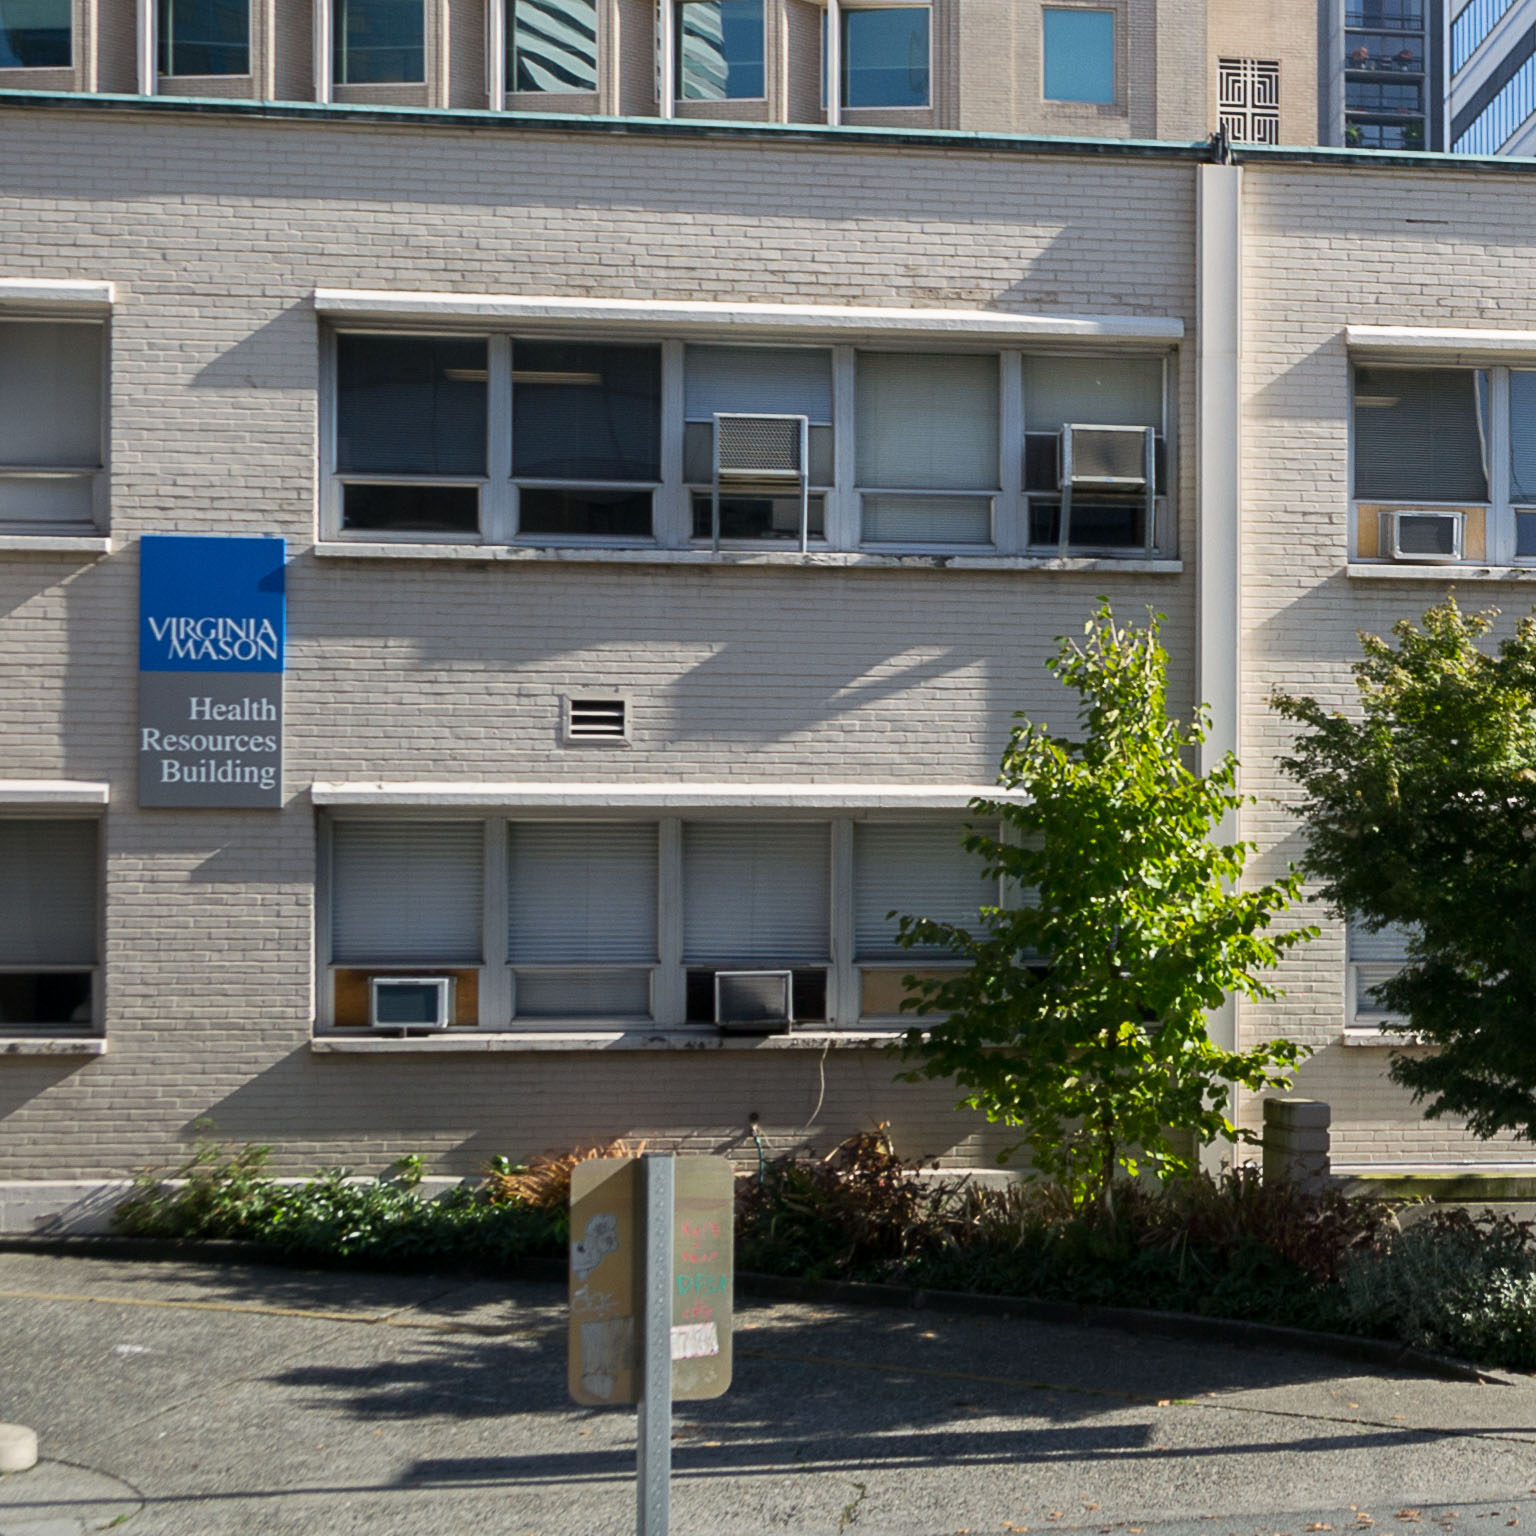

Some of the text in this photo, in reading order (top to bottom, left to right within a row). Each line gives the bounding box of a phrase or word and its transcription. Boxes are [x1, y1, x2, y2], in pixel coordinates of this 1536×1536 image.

[148, 617, 277, 641] VIRGINIA
[168, 638, 278, 660] MASON
[189, 697, 277, 721] Health
[141, 728, 277, 752] Resources
[160, 759, 277, 790] Building
